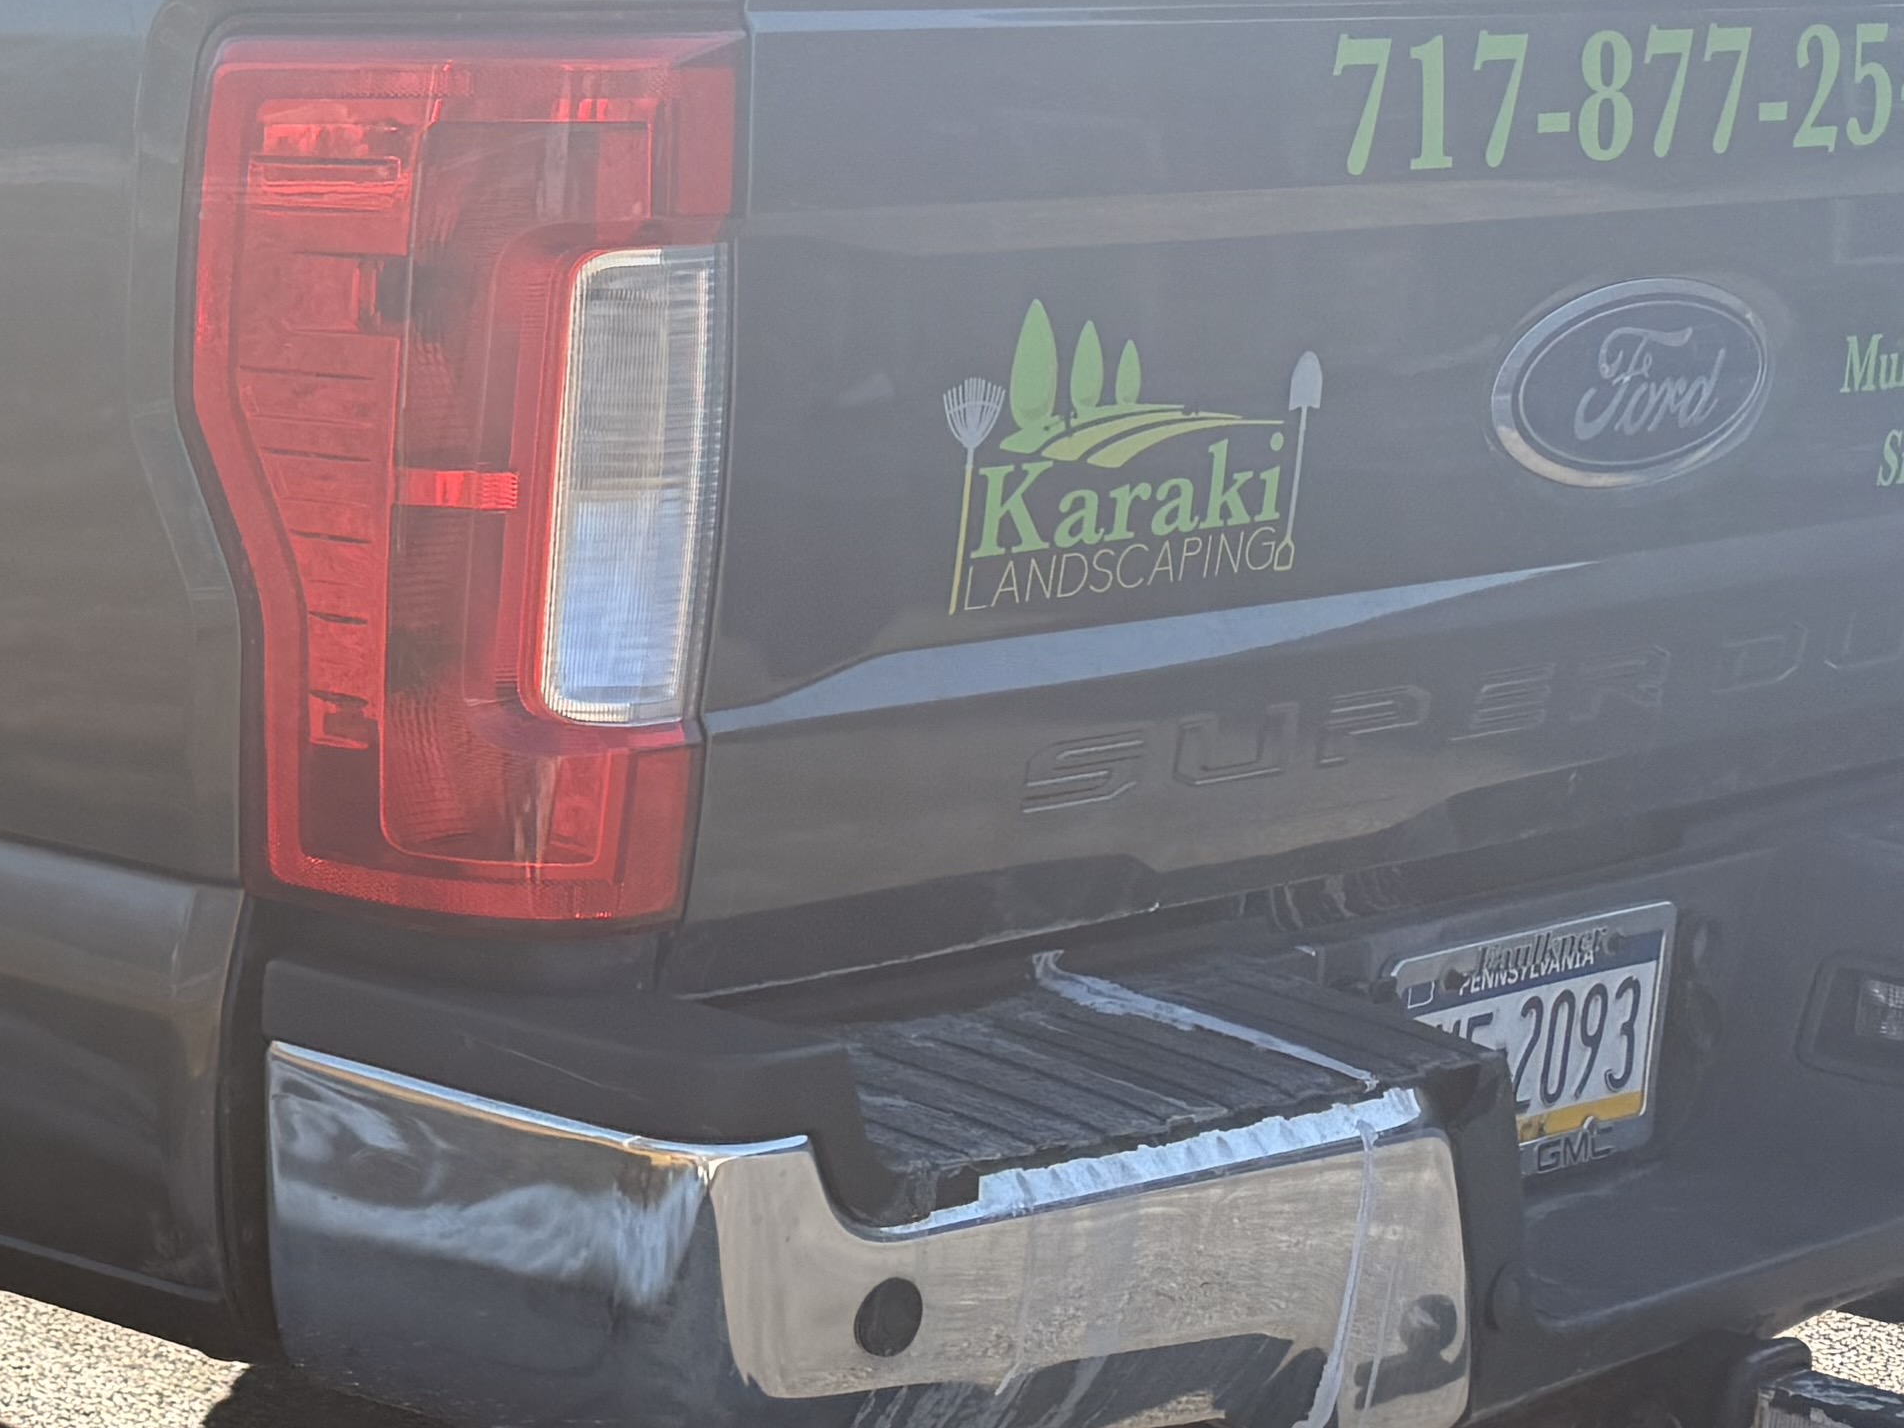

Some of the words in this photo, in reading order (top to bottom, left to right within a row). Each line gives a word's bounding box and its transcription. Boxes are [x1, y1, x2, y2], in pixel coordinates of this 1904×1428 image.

[1332, 22, 1904, 176] 717-877-25
[1573, 324, 1727, 441] Ford
[971, 432, 1284, 559] Karaki
[963, 524, 1278, 612] LANDSCAPING
[1020, 644, 1672, 815] SUPER
[1475, 926, 1608, 970] Faulkner
[1536, 1124, 1614, 1173] GMC
